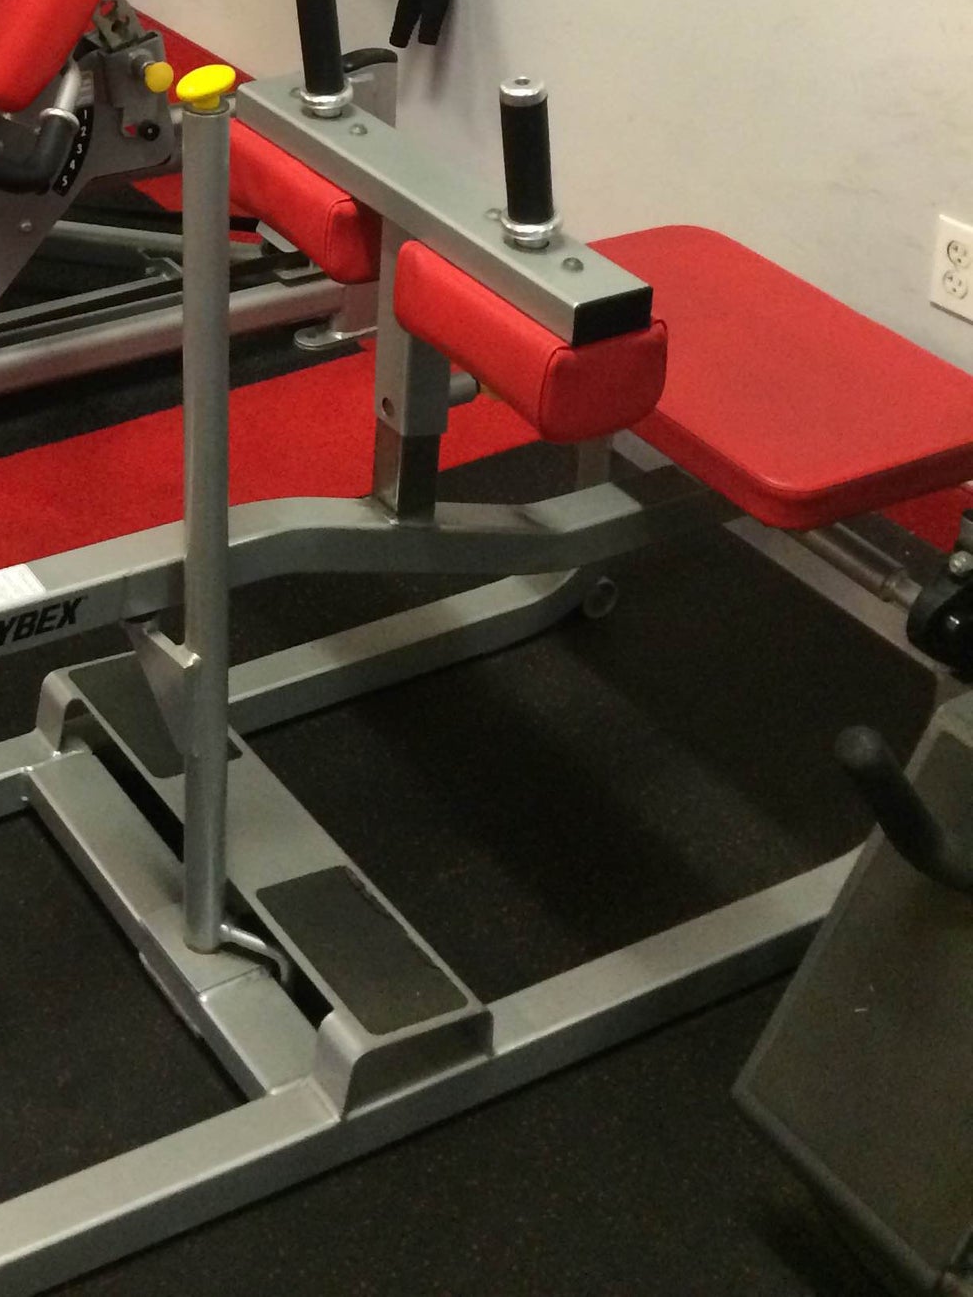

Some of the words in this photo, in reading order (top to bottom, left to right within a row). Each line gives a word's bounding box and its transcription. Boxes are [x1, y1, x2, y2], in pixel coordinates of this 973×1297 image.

[81, 126, 87, 137] 2
[76, 143, 83, 154] 3
[69, 159, 76, 170] 4
[61, 175, 68, 187] 5
